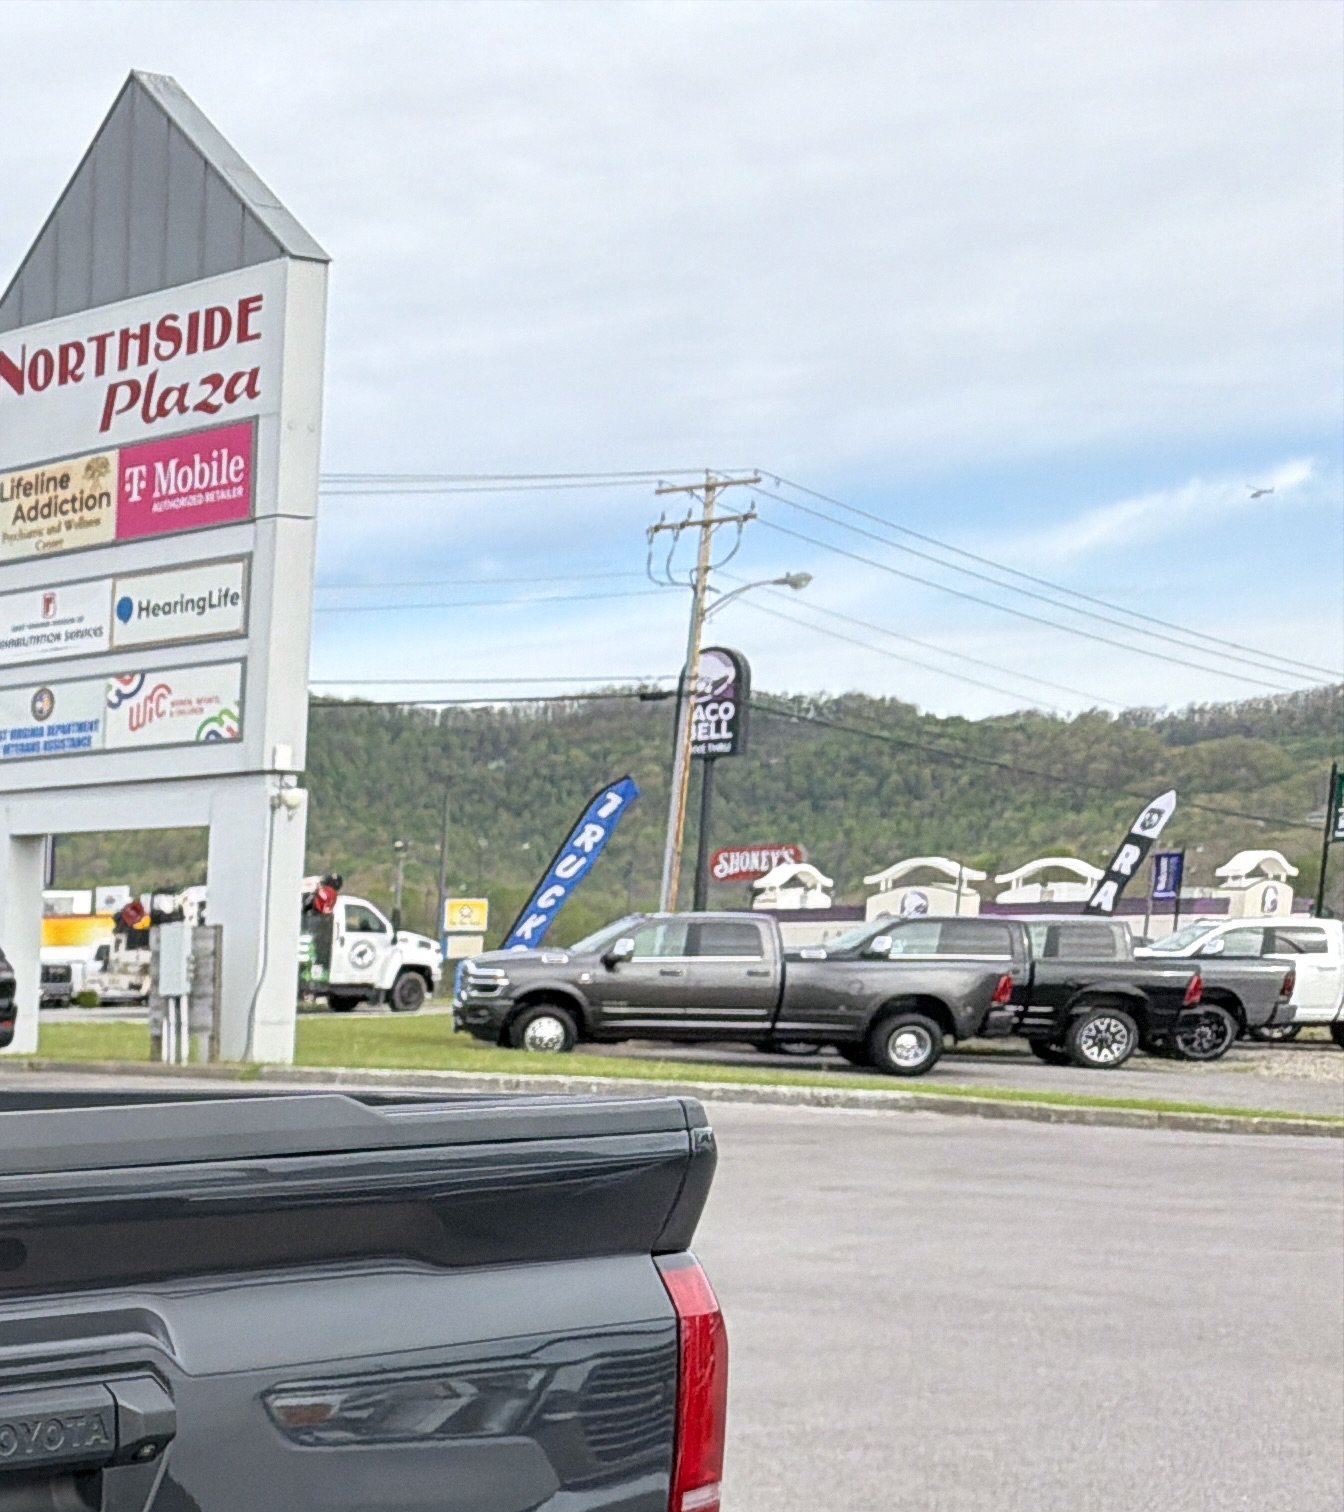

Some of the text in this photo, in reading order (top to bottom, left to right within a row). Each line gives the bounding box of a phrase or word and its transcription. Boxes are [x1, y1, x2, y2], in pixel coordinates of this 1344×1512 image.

[98, 365, 261, 433] Plaza
[0, 471, 71, 503] Lifeline
[152, 448, 245, 498] Mobile
[11, 489, 111, 526] Addiction
[137, 587, 240, 620] HearingLife
[691, 701, 736, 722] ACO
[510, 791, 623, 953] TRUCK
